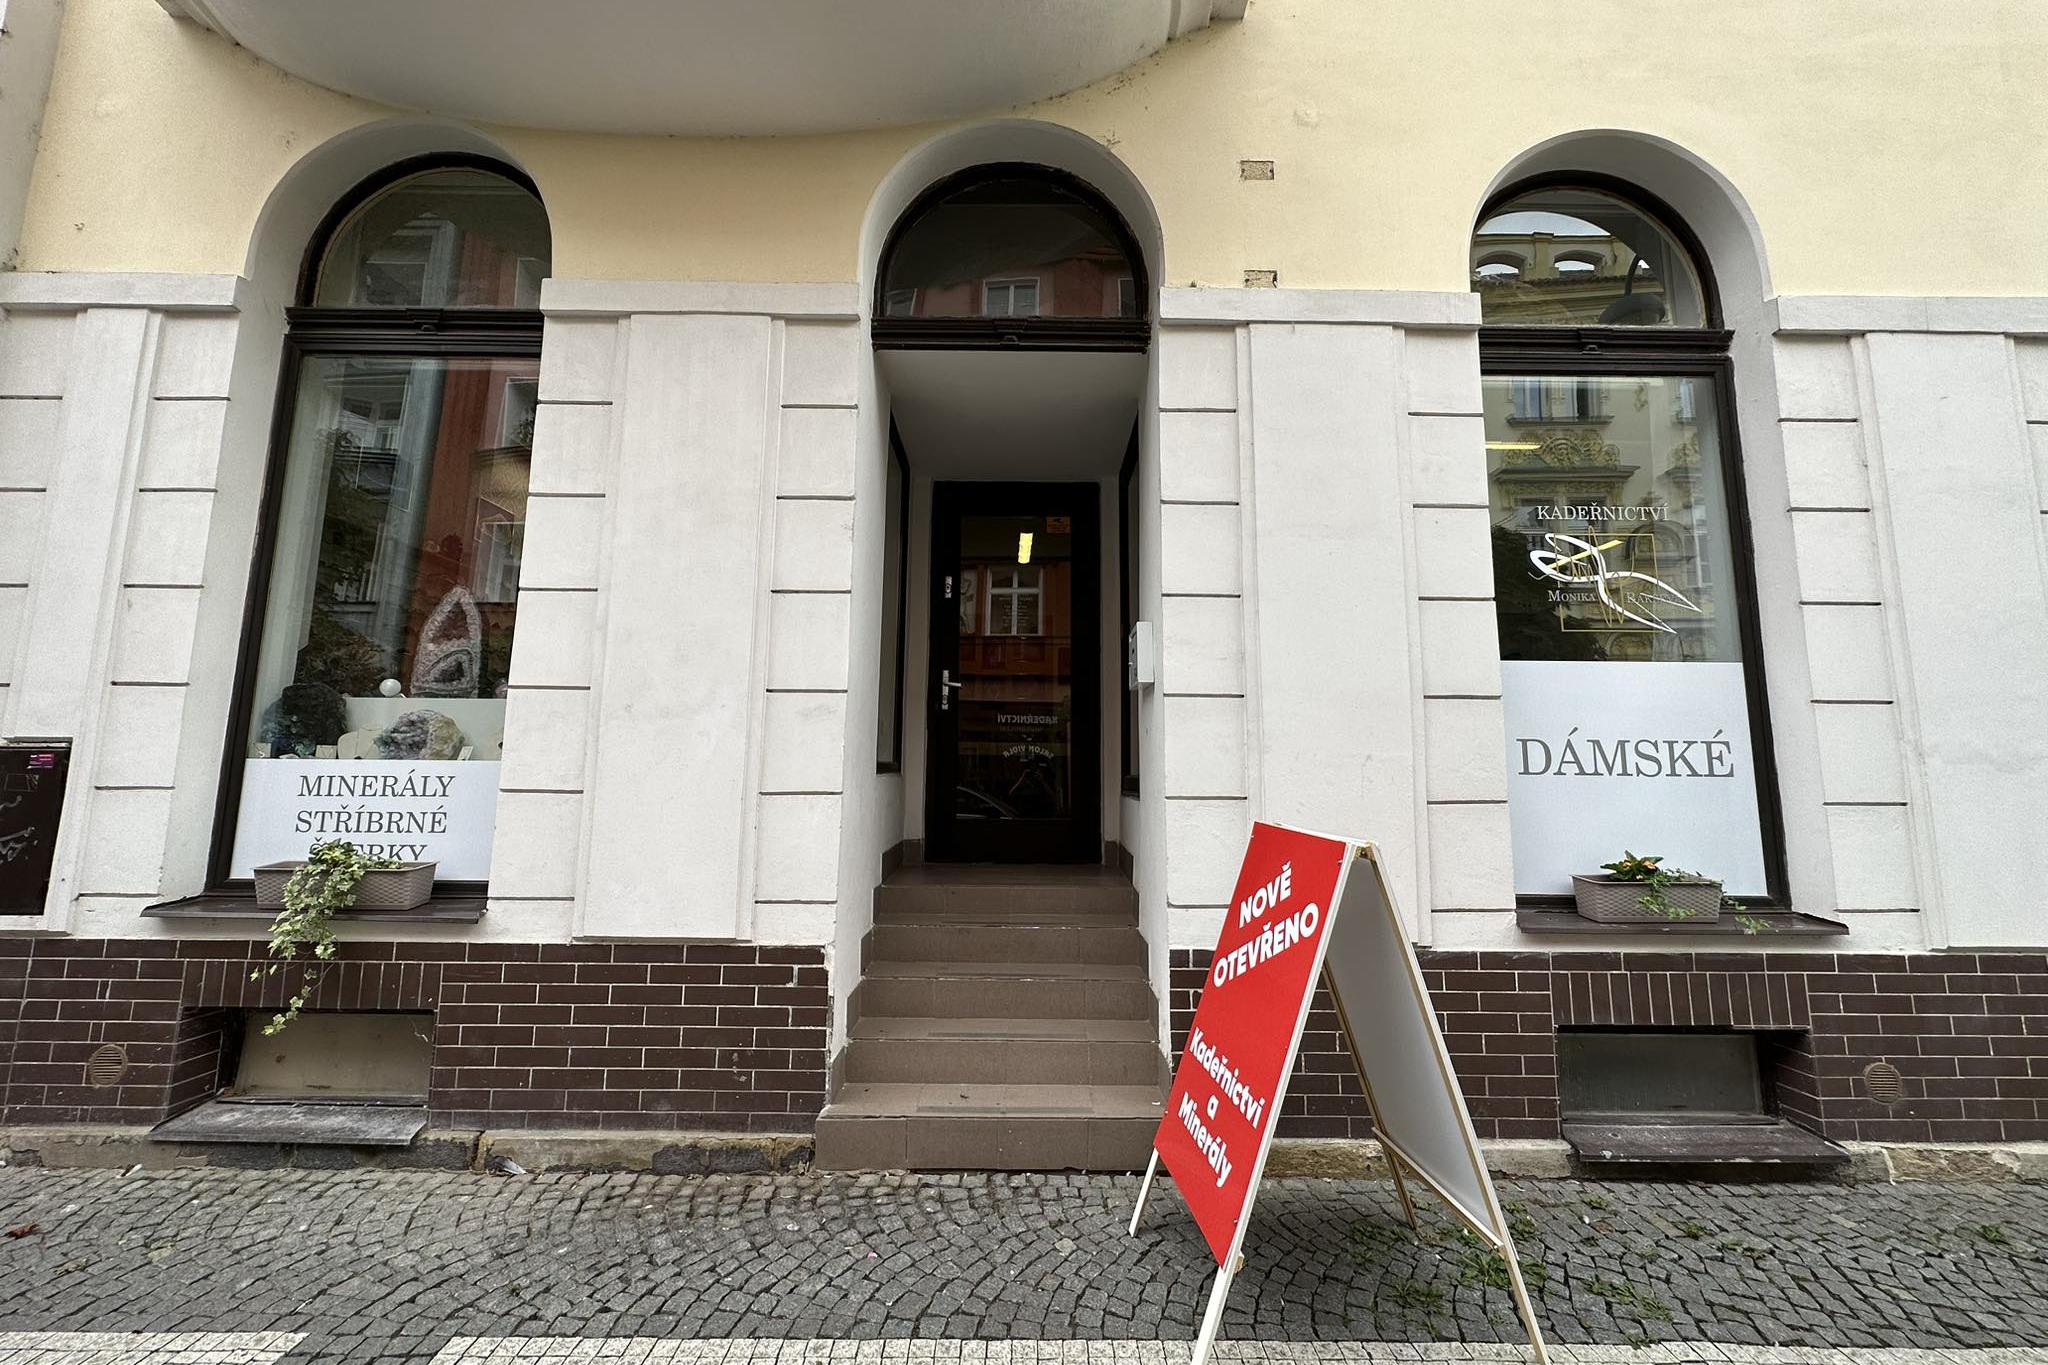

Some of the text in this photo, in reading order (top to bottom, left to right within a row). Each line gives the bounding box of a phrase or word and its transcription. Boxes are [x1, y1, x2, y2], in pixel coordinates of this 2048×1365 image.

[1536, 501, 1670, 521] KADEŘNICTVÍ
[1516, 727, 1734, 778] DÁMSKÉ
[297, 769, 456, 798] MINERÁLY
[295, 804, 448, 834] STŘÍBRNÉ
[1239, 861, 1292, 928] NOVĚ
[1213, 903, 1320, 988] OTEVŘENO
[1189, 1027, 1266, 1129] Kadeřnictví
[1207, 1095, 1218, 1120] a
[1178, 1091, 1233, 1189] Minerály
